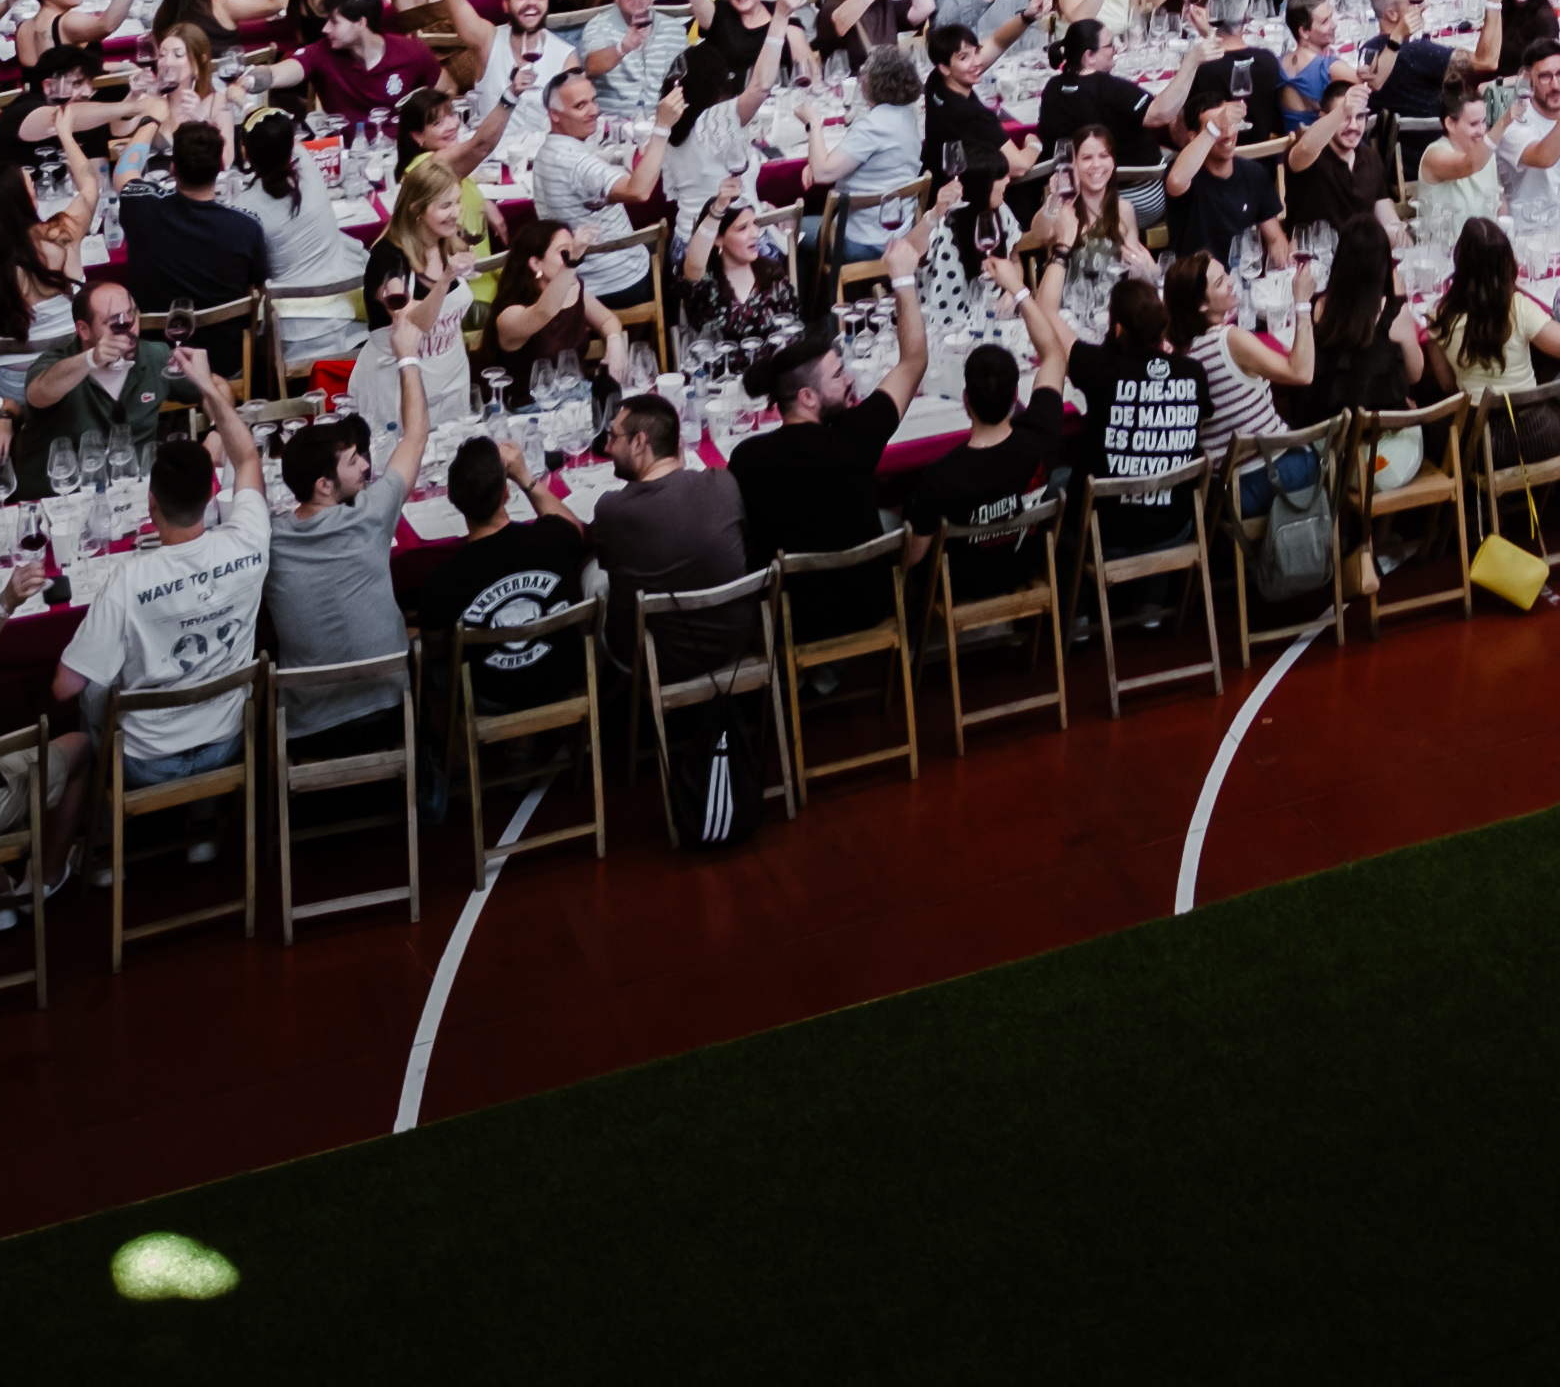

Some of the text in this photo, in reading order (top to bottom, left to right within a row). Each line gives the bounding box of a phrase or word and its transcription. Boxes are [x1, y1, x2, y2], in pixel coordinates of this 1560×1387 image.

[1116, 378, 1198, 401] LO MEJOR
[1109, 404, 1199, 428] DE MADRID
[1104, 428, 1197, 451] ES CUANDO
[1106, 454, 1169, 476] VUELVO
[136, 552, 263, 605] WAVE TO EARTH
[467, 573, 552, 618] AMSTERDAM
[499, 652, 534, 666] CREW
